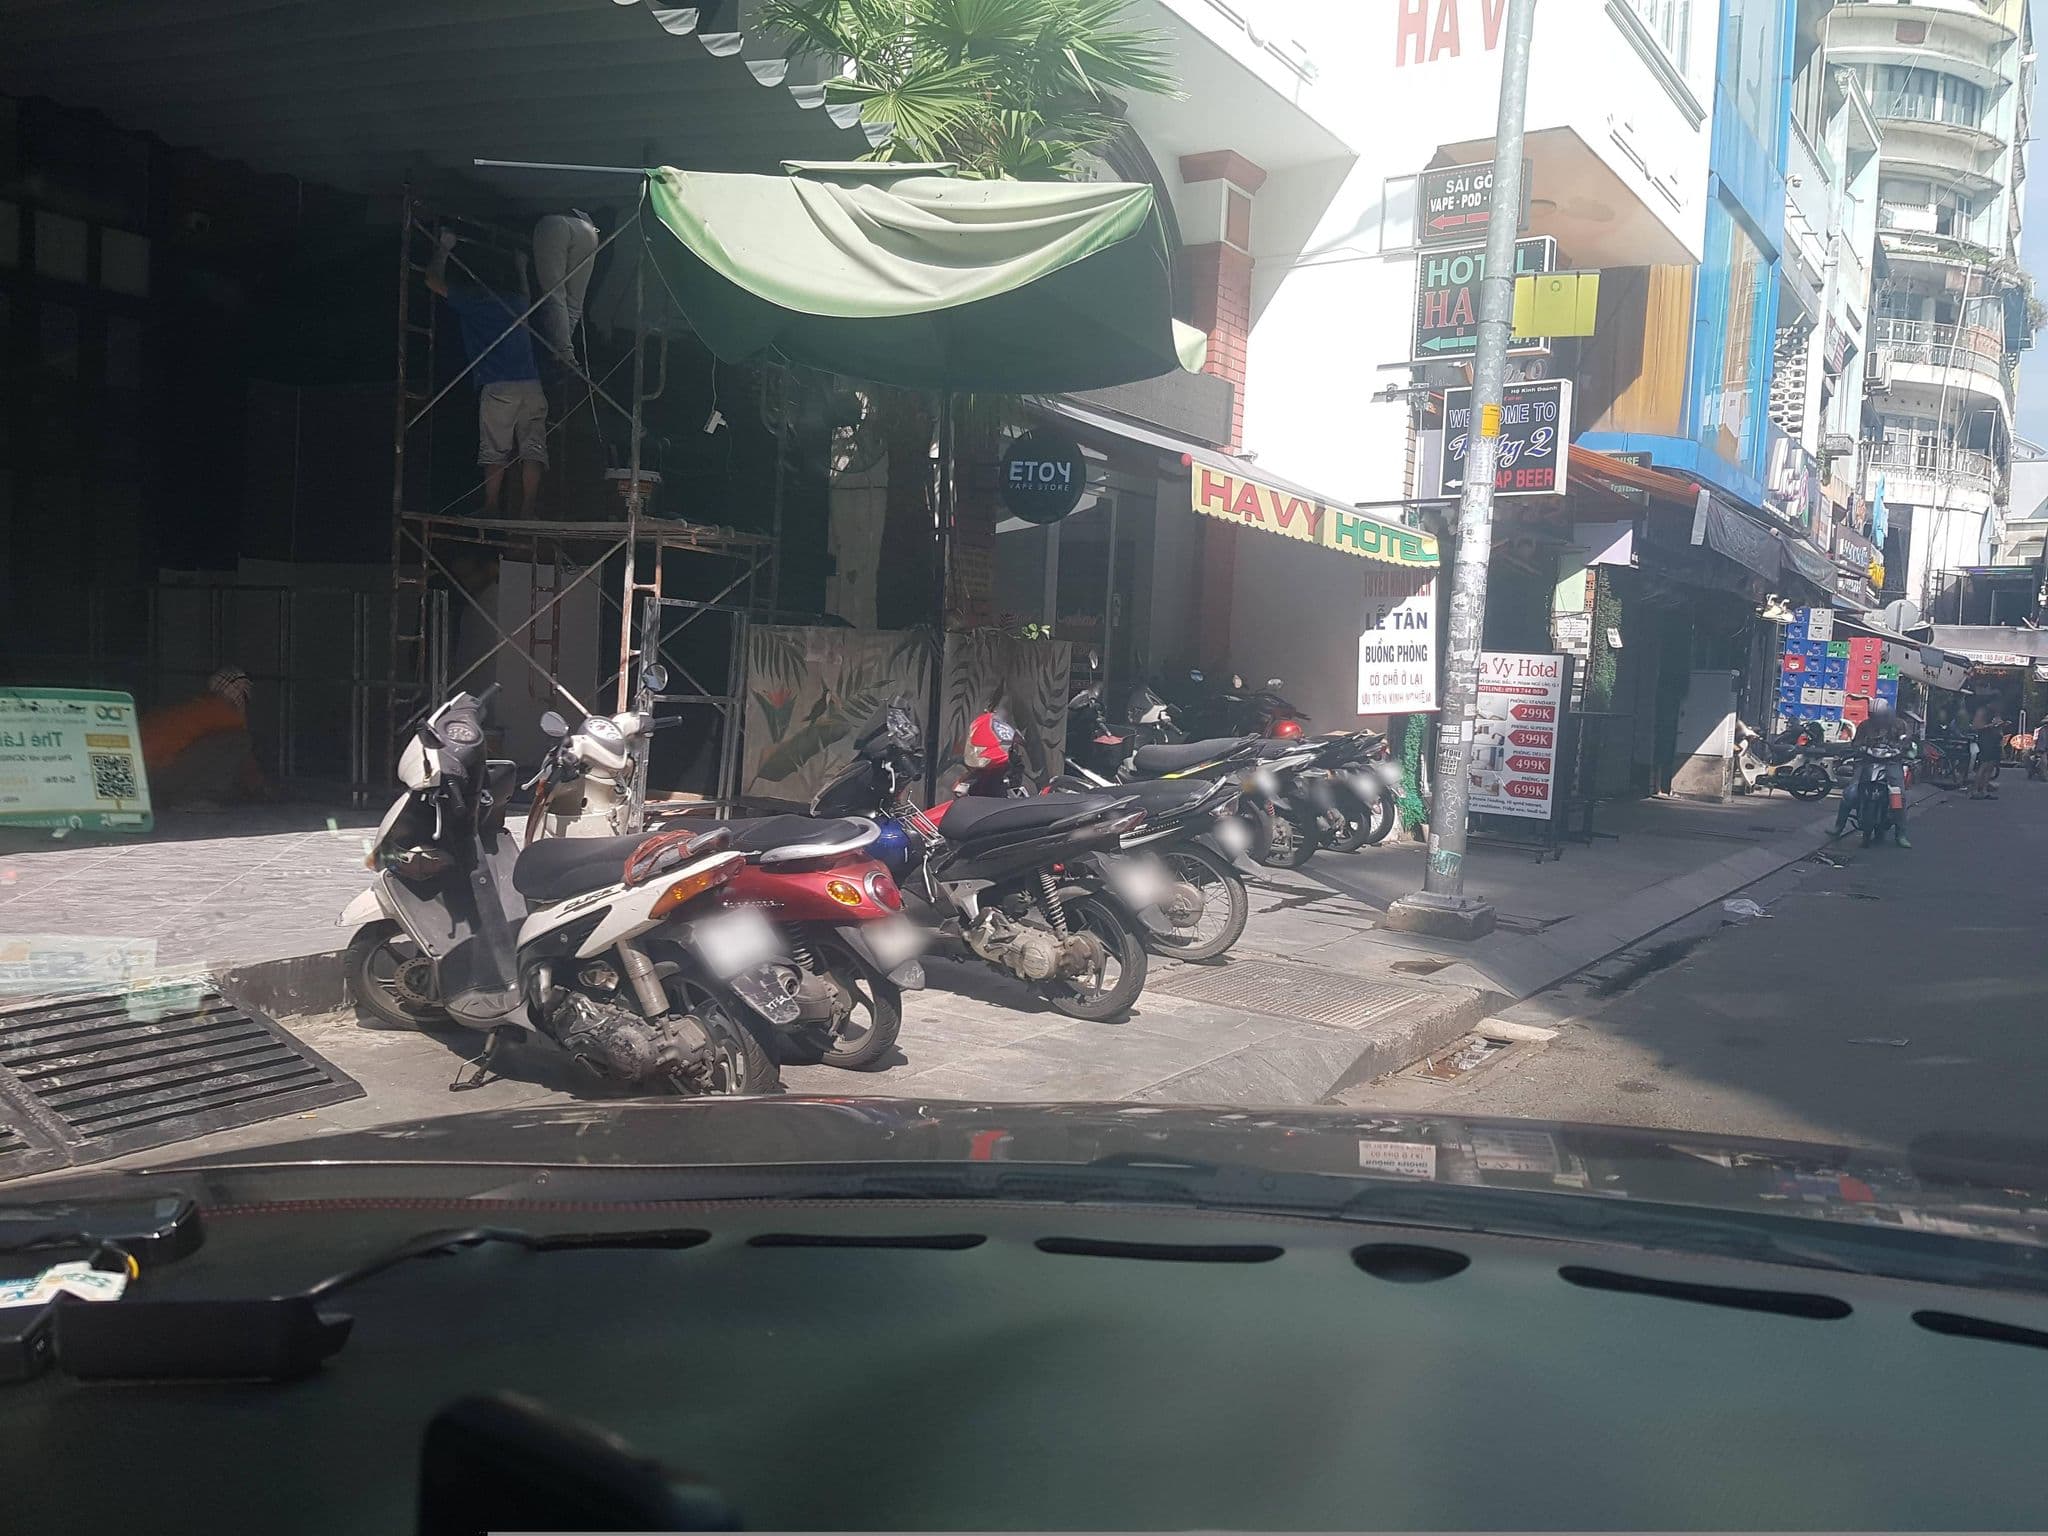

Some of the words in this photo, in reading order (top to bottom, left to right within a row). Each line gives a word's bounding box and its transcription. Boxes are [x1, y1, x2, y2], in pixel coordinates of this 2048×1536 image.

[1445, 175, 1470, 194] SÀI
[1473, 170, 1493, 190] GÒ
[1430, 195, 1455, 213] VAPE
[1461, 192, 1481, 208] POD
[1427, 249, 1534, 288] HOTL
[1422, 287, 1475, 336] HẠ
[1449, 402, 1529, 429] WEOME
[1533, 401, 1556, 423] TO
[1448, 433, 1525, 468] Rby
[1524, 426, 1554, 458] 2
[1494, 470, 1512, 489] AP
[1516, 468, 1554, 488] BEER
[1335, 512, 1438, 563] HOTEL
[1365, 604, 1386, 631] LỄ
[1393, 607, 1427, 630] TÂN
[1365, 637, 1395, 663] BUỒNG
[1397, 640, 1427, 663] PHÒNG
[1480, 663, 1488, 674] a
[1492, 657, 1514, 678] Vy
[1518, 658, 1558, 678] Hotel
[1521, 707, 1551, 719] 299K
[1518, 733, 1548, 745] 399K
[1516, 759, 1546, 771] 499K
[1514, 785, 1544, 797] 699K
